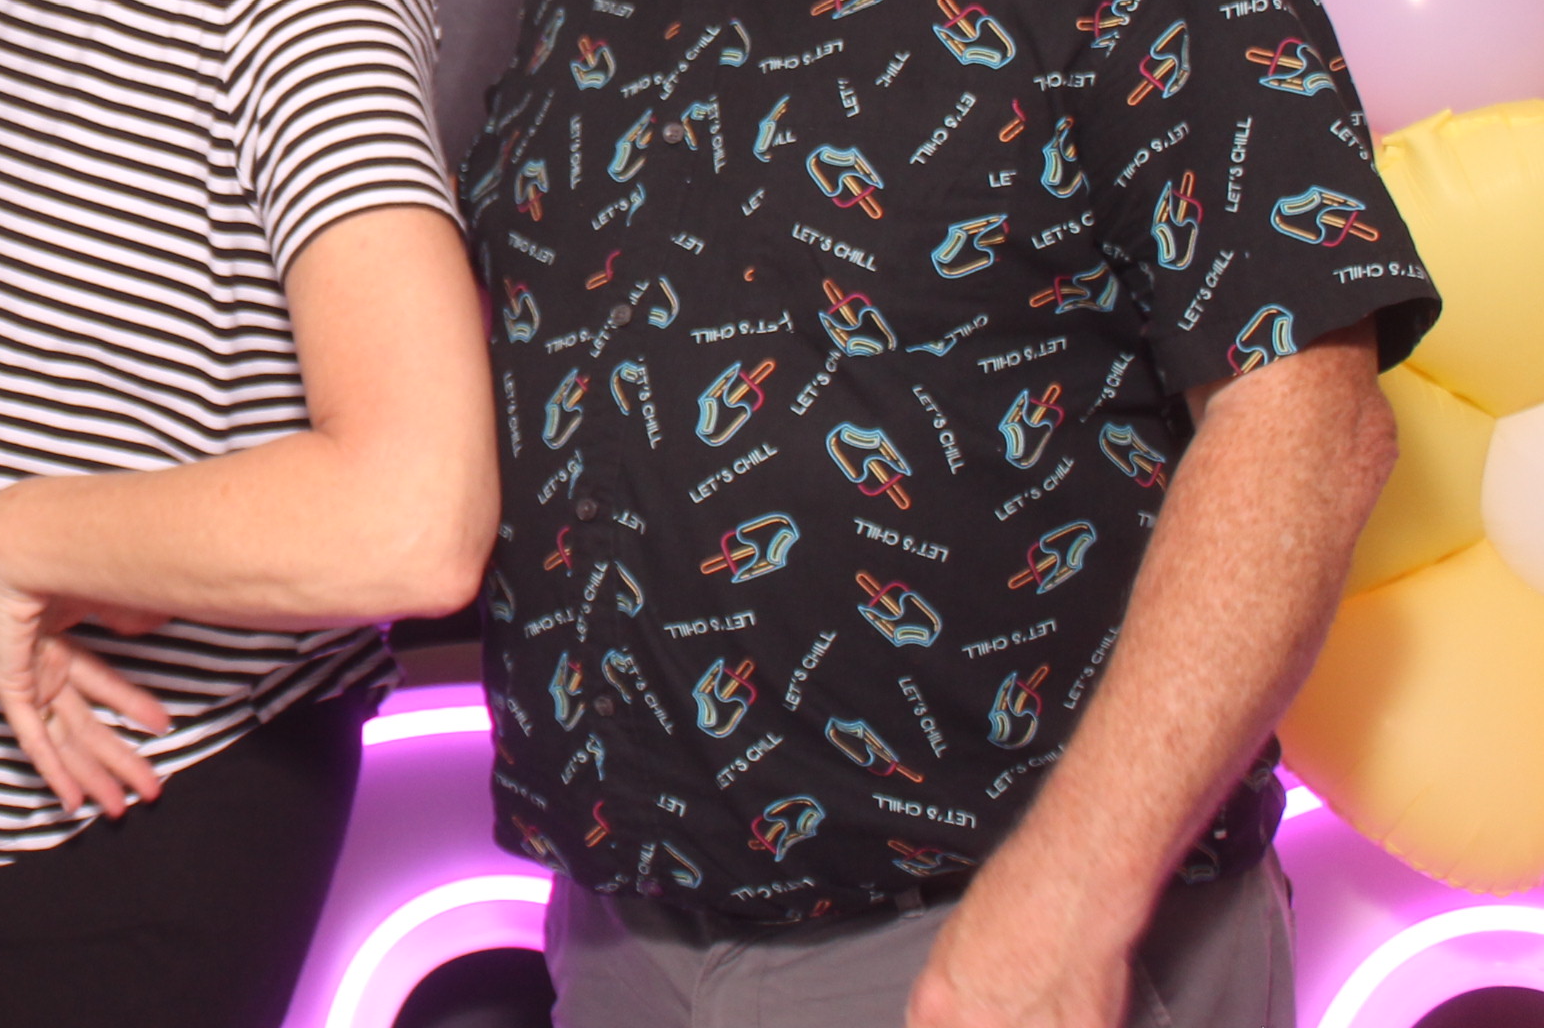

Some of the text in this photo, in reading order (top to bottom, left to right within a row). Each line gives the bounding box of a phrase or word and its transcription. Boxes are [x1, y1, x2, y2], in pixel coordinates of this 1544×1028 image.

[685, 27, 721, 61] CHILL
[759, 40, 844, 74] LET'S CHILL
[711, 134, 726, 174] CHILL
[909, 129, 949, 165] CHILL
[1116, 122, 1189, 188] LET'S CHILL
[1225, 117, 1252, 213] LET'S CHILL
[591, 199, 629, 231] LET'S
[792, 224, 876, 272] LET'S CHILL
[1031, 221, 1081, 250] LET'S
[1177, 251, 1234, 332] LET'S CHILL
[1333, 264, 1384, 284] CHILL
[545, 333, 577, 354] CHILL
[690, 325, 736, 344] CHILL
[977, 337, 1067, 374] LET'S CHILL
[1105, 354, 1134, 388] CHILL
[635, 356, 662, 450] ET'S CHILL
[790, 373, 831, 416] LET'S
[912, 386, 964, 475] LET'S CHILL
[537, 470, 568, 505] LET'S
[688, 444, 778, 504] LET'S CHILL
[994, 457, 1074, 522] LET'S CHILL
[854, 518, 949, 563] LET'S CHILL
[584, 563, 608, 602] CHILL
[663, 611, 755, 639] LET'S CHILL
[961, 619, 1057, 659] LET'S CHILL
[785, 632, 837, 711] LET'S CHILL
[1063, 626, 1126, 710] LET'S CHILL
[644, 692, 673, 735] CHILL
[898, 677, 947, 759] LET'S CHILL
[561, 751, 588, 785] LET'S
[985, 766, 1027, 800] LET'S
[872, 794, 976, 829] LET'S CHILL
